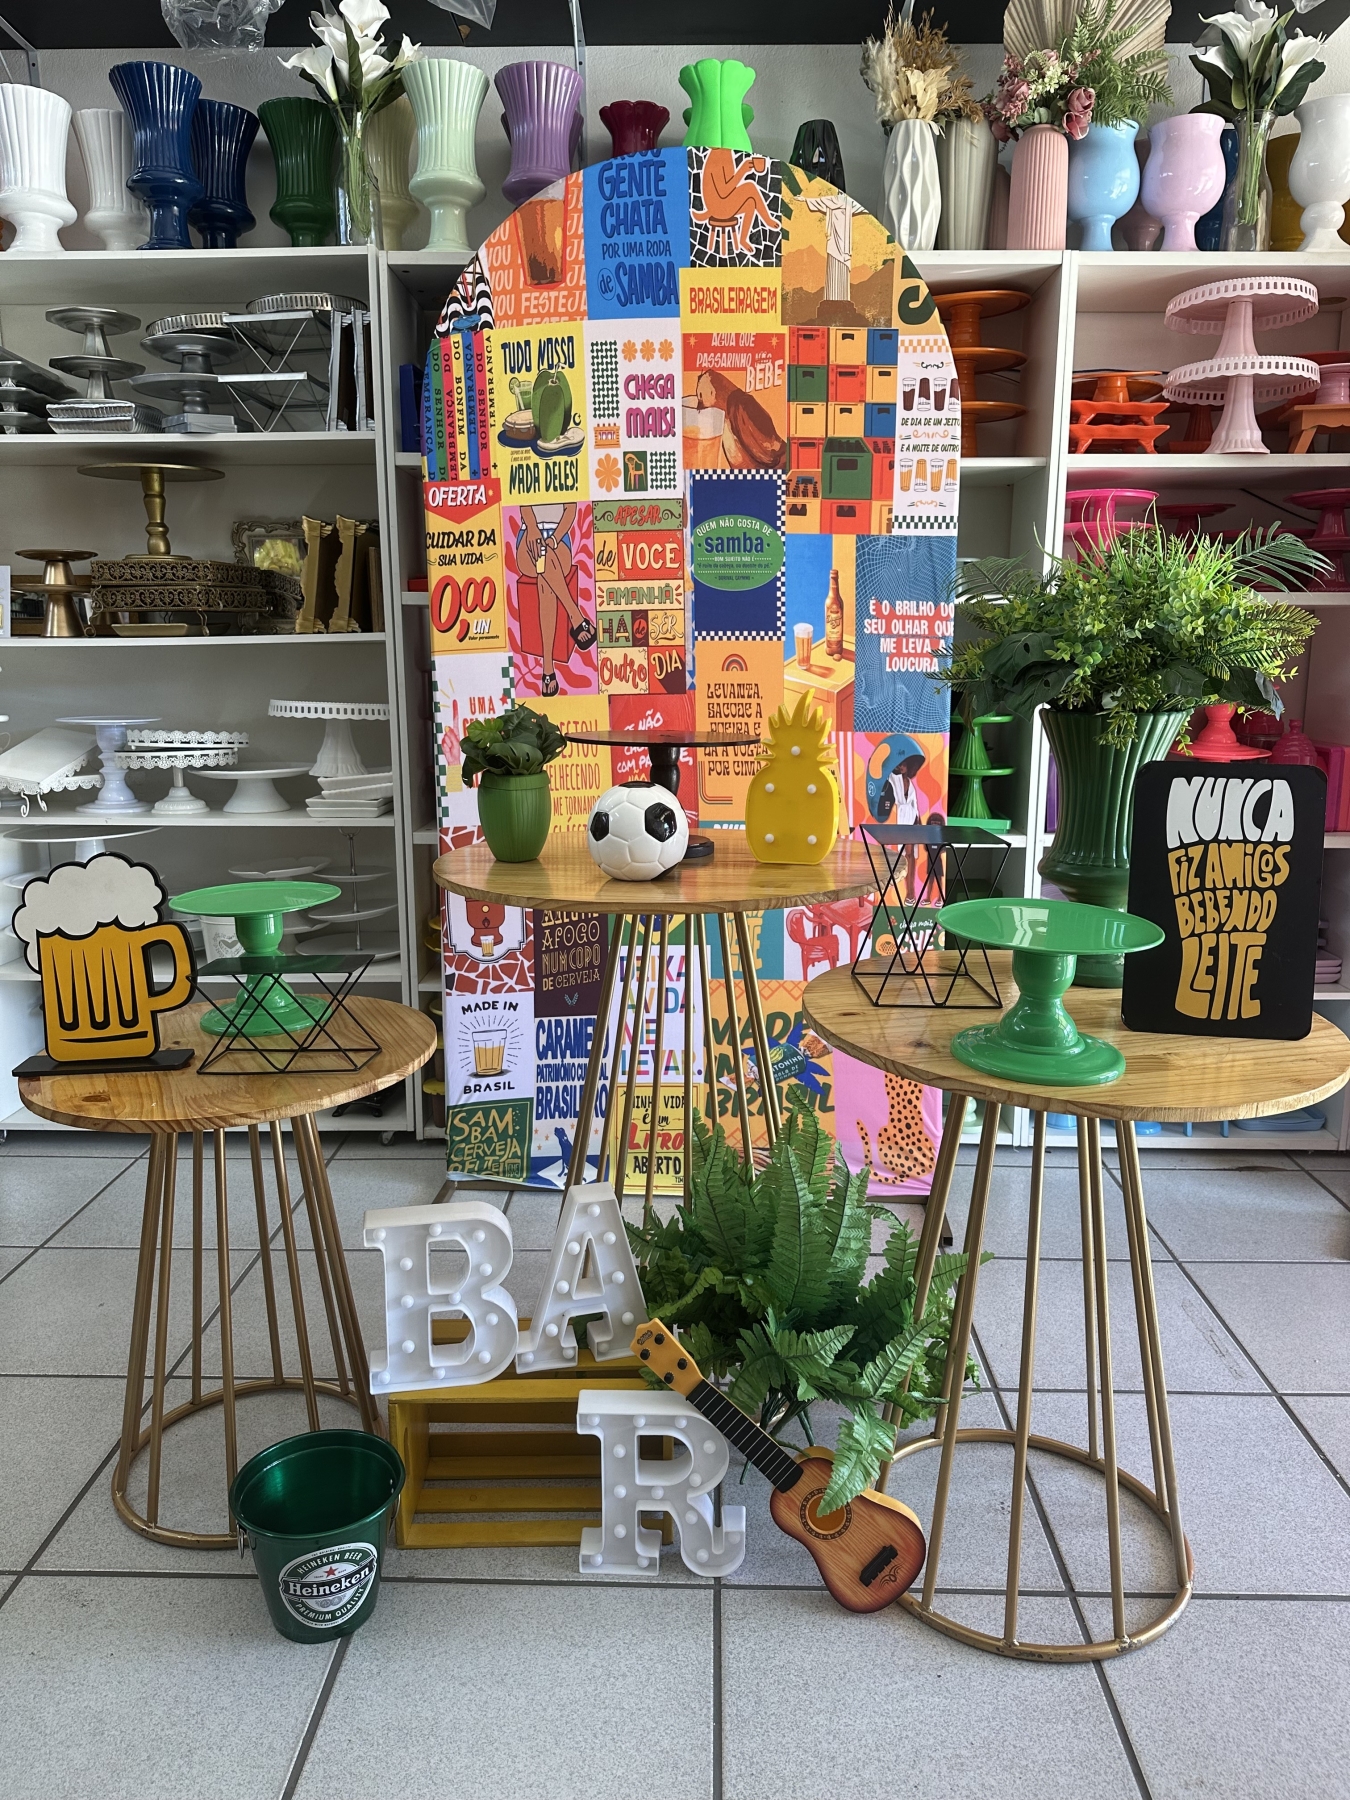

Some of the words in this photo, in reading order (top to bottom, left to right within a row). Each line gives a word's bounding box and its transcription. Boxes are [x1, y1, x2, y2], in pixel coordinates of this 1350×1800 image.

[598, 159, 667, 201] GENTE
[600, 199, 668, 238] CHATA
[487, 220, 509, 243] OU
[602, 242, 620, 260] POR
[622, 241, 645, 258] UMA
[646, 240, 672, 257] RODA
[600, 274, 614, 294] de
[614, 261, 680, 307] SAMBA
[689, 286, 778, 315] BRASILEIRAGEM
[453, 340, 461, 360] DO
[739, 333, 756, 347] QUE
[432, 352, 441, 372] DO
[443, 353, 451, 373] DO
[476, 352, 484, 373] DO
[501, 339, 532, 374] TUDO
[537, 335, 575, 372] NOSSO
[696, 353, 752, 368] PASSARINHO
[624, 373, 675, 401] CHEGA
[745, 359, 783, 393] BEBE
[465, 342, 476, 435] LEMBRANÇA
[455, 376, 465, 435] BONFIM
[434, 388, 445, 450] SENHOR
[478, 389, 488, 451] SENHOR
[626, 406, 676, 438] MAIS!
[901, 418, 909, 426] DE
[910, 418, 922, 426] DIA
[924, 418, 932, 426] DE
[933, 418, 942, 426] UM
[445, 389, 457, 482] LEMBRANÇA
[900, 444, 905, 452] E
[906, 444, 911, 452] A
[912, 444, 930, 452] NOITE
[931, 444, 940, 452] DE
[941, 444, 959, 452] OUTRO
[459, 452, 467, 472] DA
[509, 462, 540, 495] NADA
[545, 458, 579, 492] DELES!
[428, 484, 487, 507] OFERTA
[614, 505, 662, 527] APESAR
[696, 520, 717, 537] QUEM
[719, 518, 734, 528] NÃO
[737, 518, 760, 531] GOSTA
[762, 525, 773, 537] DE
[425, 531, 474, 549] CUIDAR
[477, 529, 496, 547] DA
[704, 531, 764, 554] samba
[438, 554, 457, 566] SUA
[460, 552, 484, 565] VIDA
[597, 540, 617, 569] de
[622, 538, 681, 570] VOCÊ
[605, 583, 674, 605] AMANHÃ
[869, 596, 876, 615] É
[882, 600, 890, 615] O
[896, 600, 935, 617] BRILHO
[473, 618, 491, 634] UN
[598, 615, 630, 643] HÁ
[634, 620, 646, 636] de
[864, 619, 885, 634] SEU
[891, 619, 928, 635] OLHAR
[880, 637, 897, 653] ME
[902, 638, 931, 653] LEVA
[599, 653, 647, 689] Outro
[650, 649, 683, 680] DIA
[886, 656, 939, 672] LOUCURA
[469, 695, 496, 715] UMA
[708, 702, 753, 719] SACODE
[756, 702, 763, 719] A
[638, 709, 663, 731] NÃO
[617, 759, 635, 773] COM
[708, 761, 730, 776] POR
[733, 761, 762, 776] CIMA
[553, 797, 563, 816] ME
[565, 795, 601, 816] TORNAN
[1166, 776, 1294, 849] NUNCA
[1174, 889, 1277, 938] BEBENDO
[542, 949, 568, 975] NUM
[569, 943, 600, 970] COPO
[542, 977, 554, 991] DE
[555, 968, 601, 988] CERVEJA
[1174, 931, 1267, 1020] LEITE
[461, 1001, 500, 1016] MADE
[503, 1001, 519, 1011] IN
[643, 987, 696, 1013] VDA
[463, 1081, 516, 1095] BRASIL
[453, 1107, 513, 1140] SAM
[471, 1126, 498, 1143] BA
[451, 1138, 522, 1162] CERVEJA
[633, 1155, 682, 1175] ABRTO
[297, 1553, 340, 1575] HEINEKEN
[344, 1551, 363, 1560] BEER
[289, 1567, 370, 1596] Heineken
[296, 1603, 332, 1620] PREMIUM
[335, 1588, 364, 1617] QUALITY
